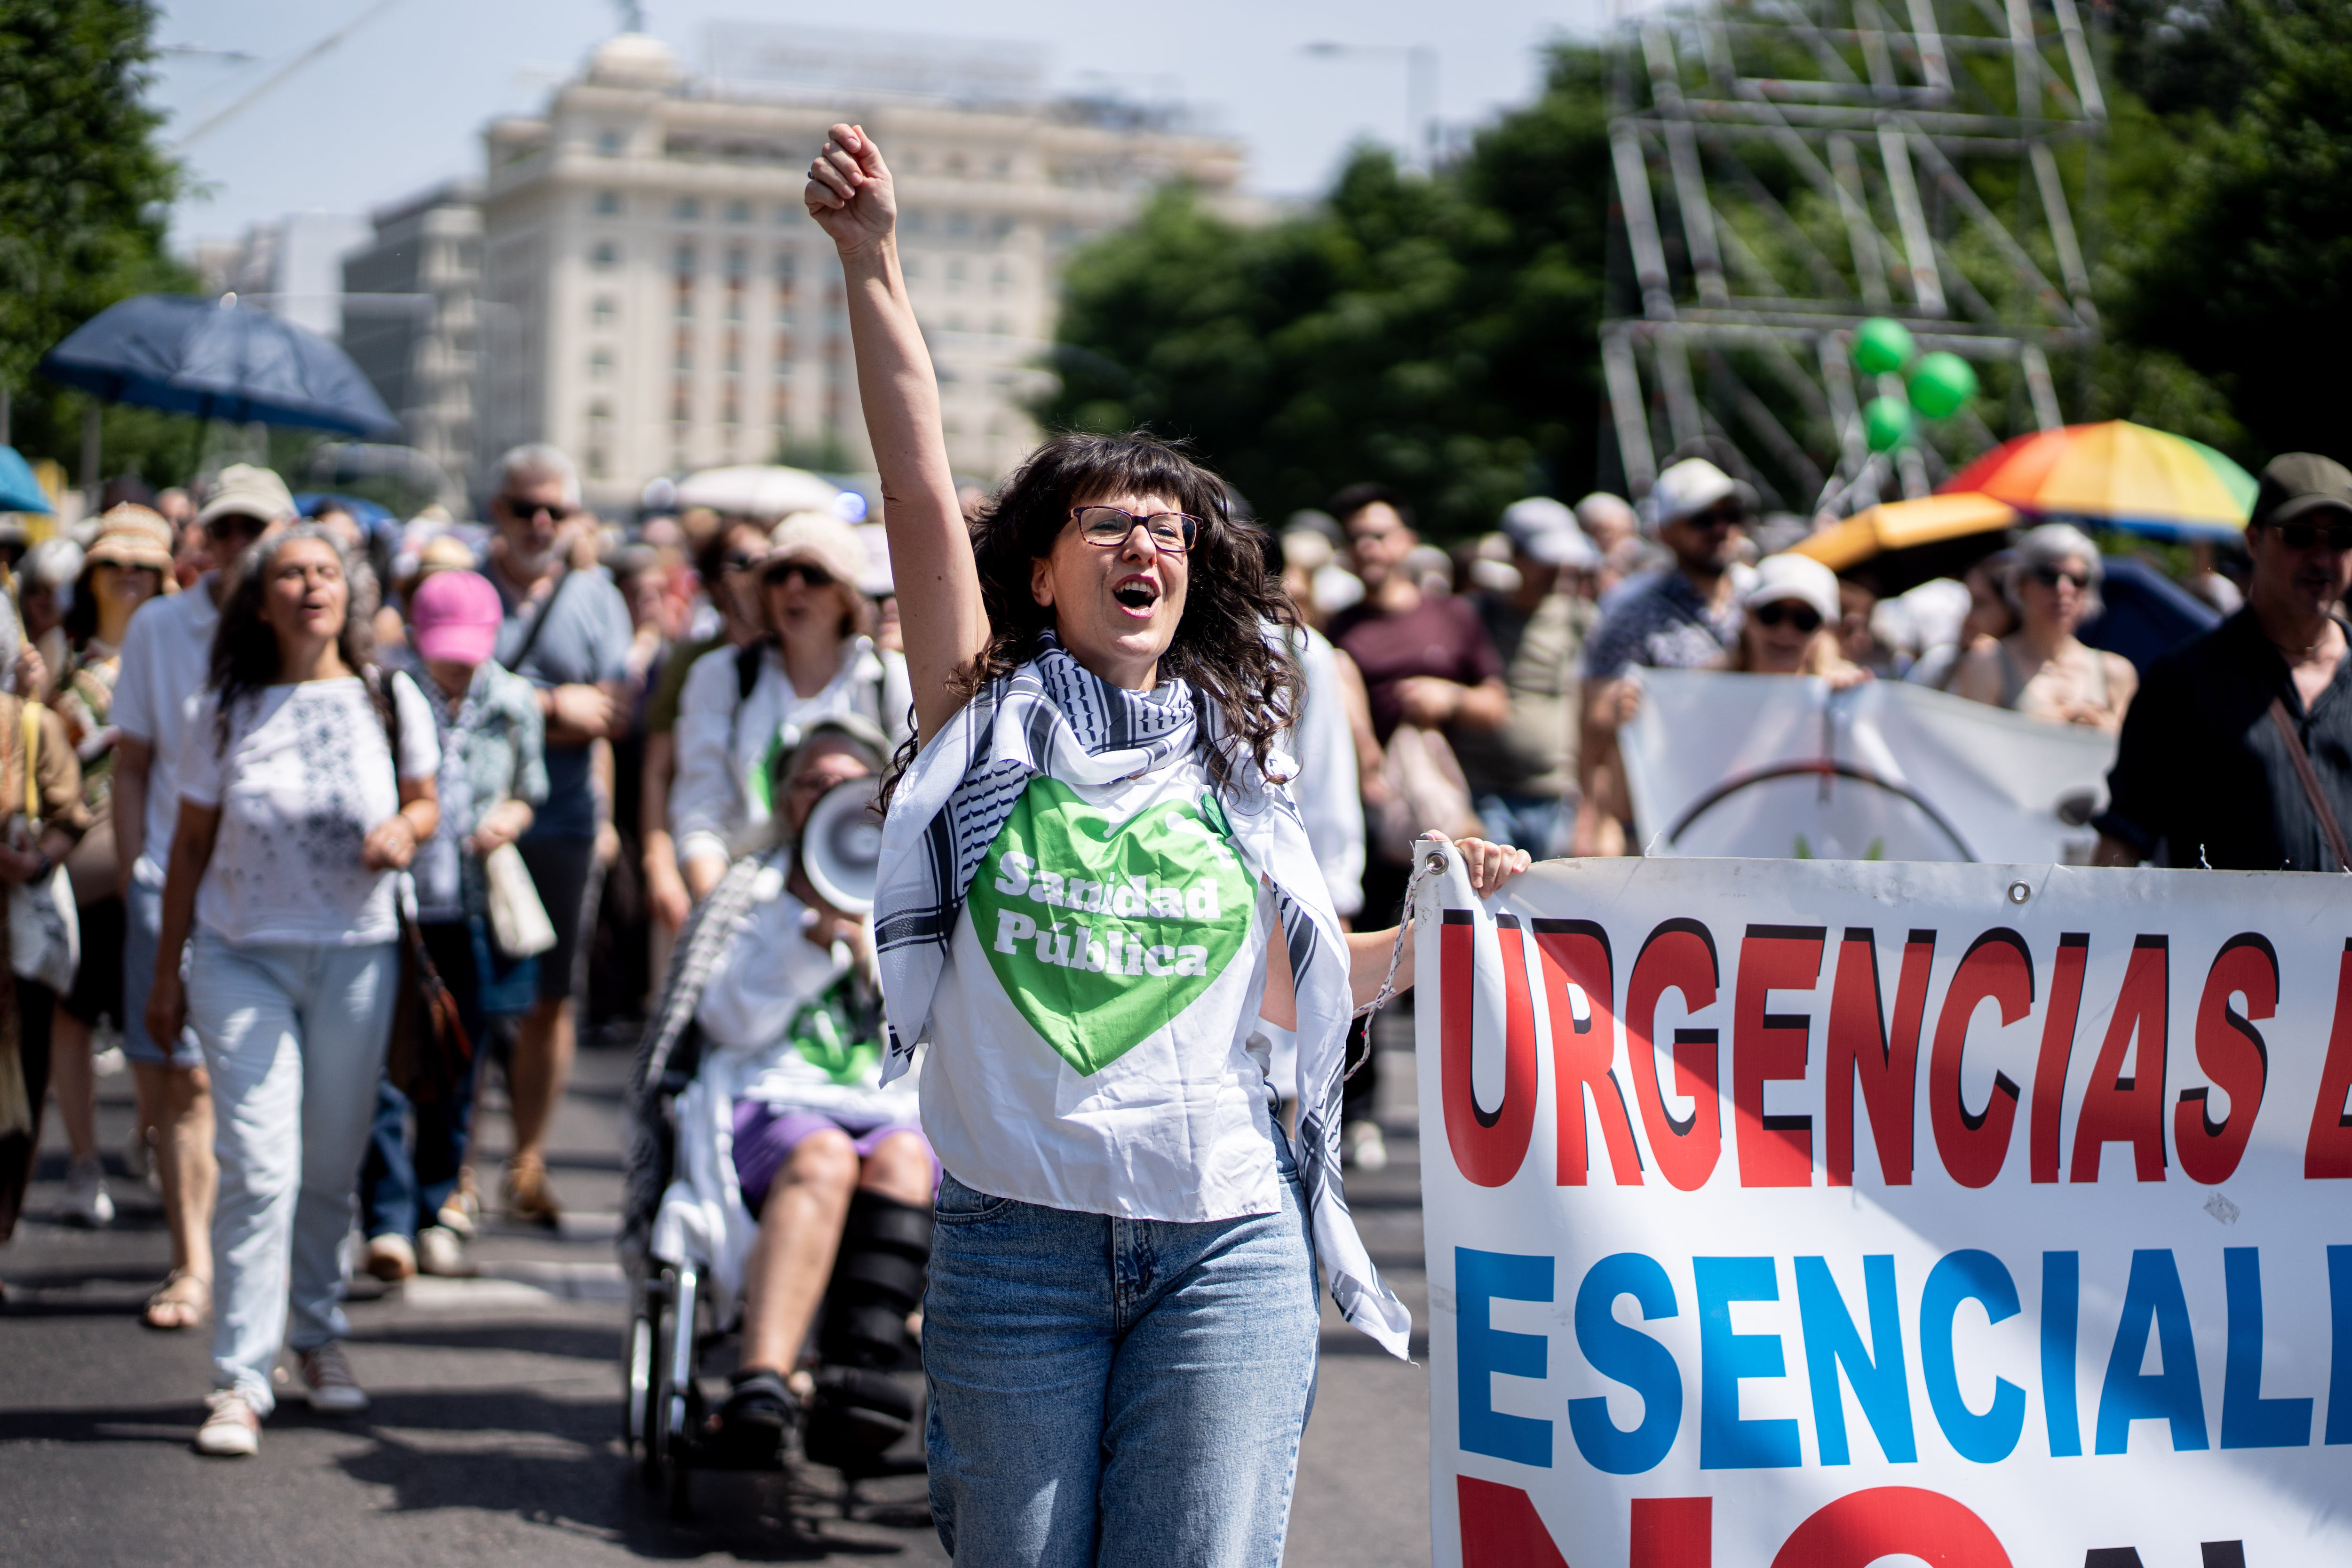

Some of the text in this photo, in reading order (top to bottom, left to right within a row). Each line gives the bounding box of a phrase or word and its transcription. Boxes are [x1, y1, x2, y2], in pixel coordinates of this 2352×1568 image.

[994, 851, 1222, 920] Sanidad
[994, 908, 1208, 977] Pública
[1440, 909, 2280, 1191] URGENCIAS
[1454, 1244, 2352, 1475] ESENCIAL
